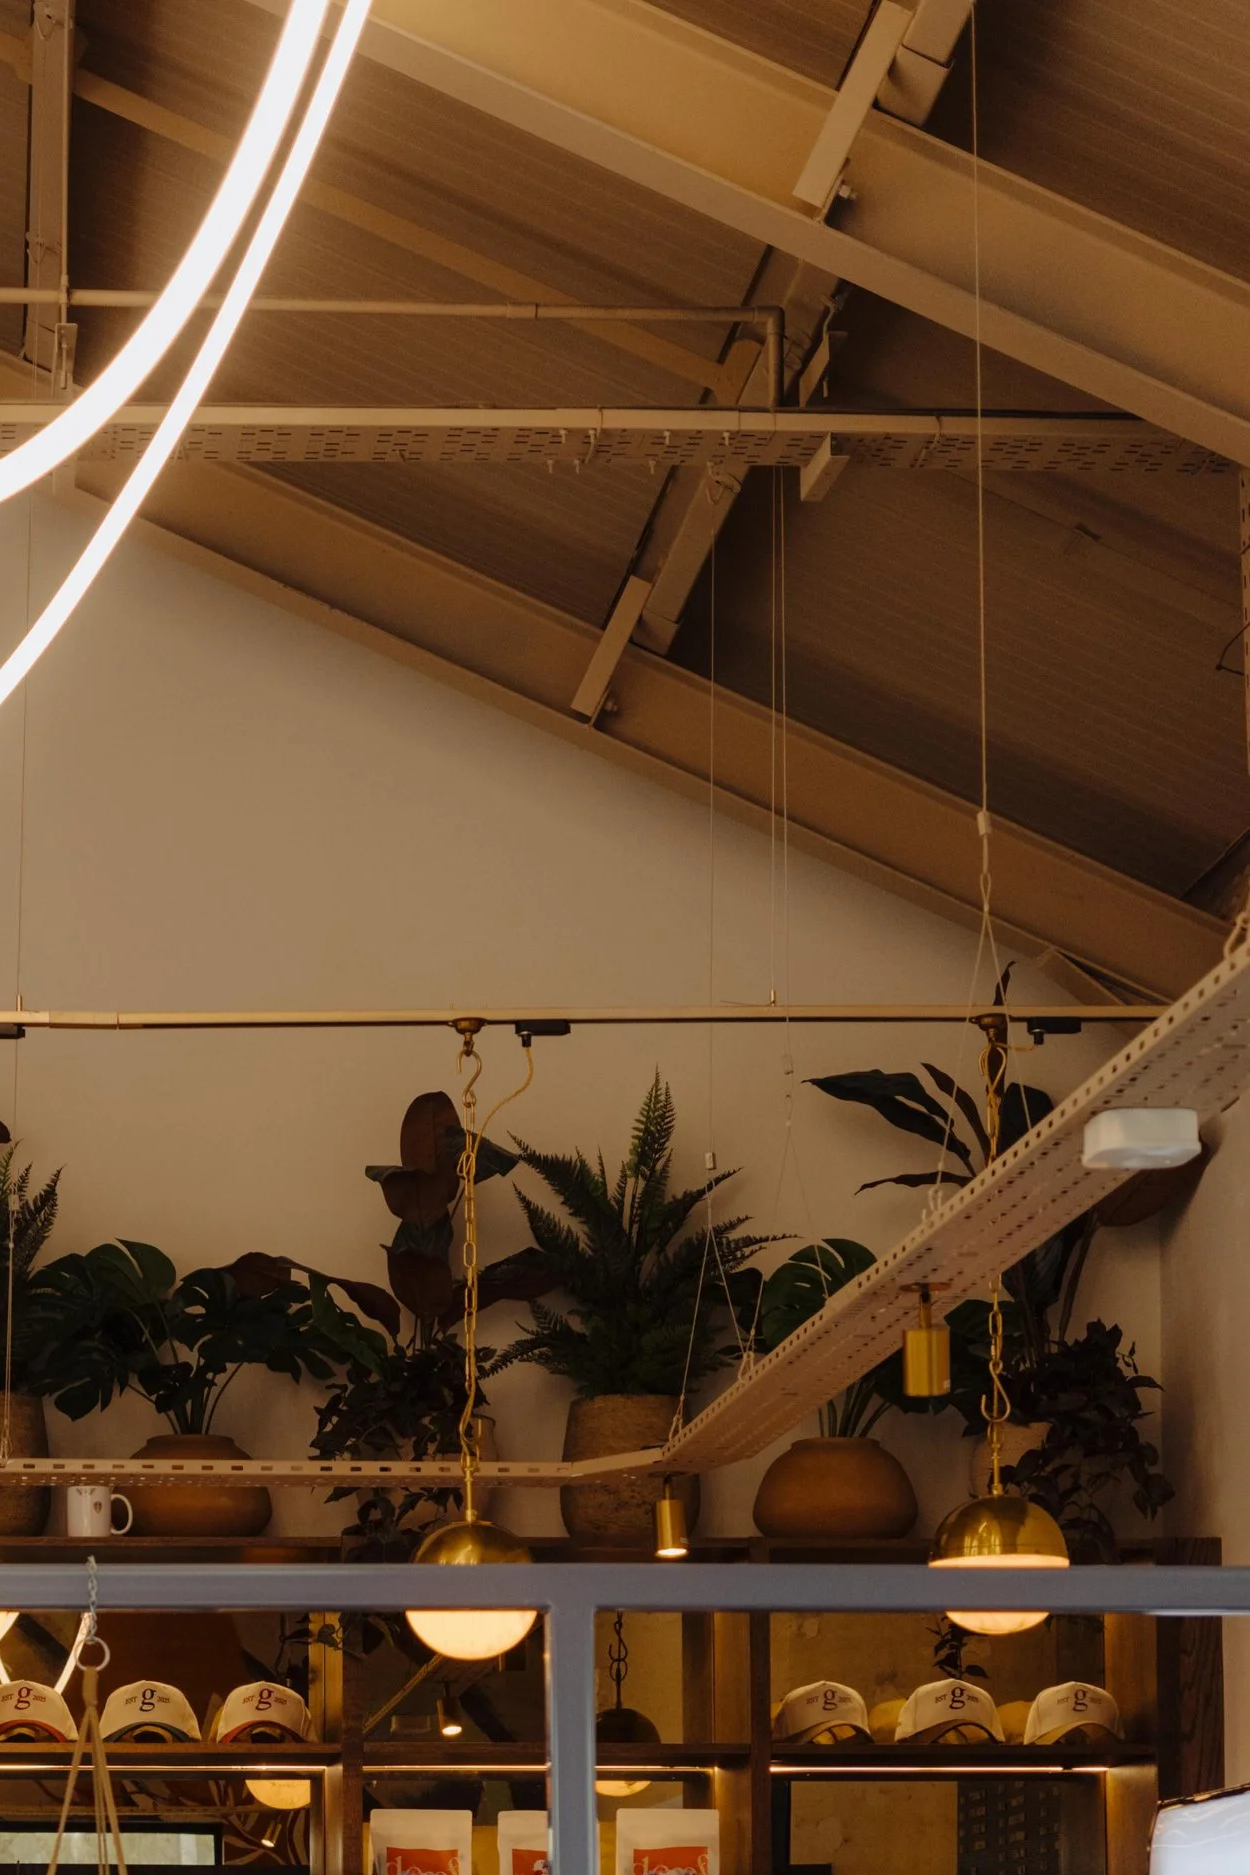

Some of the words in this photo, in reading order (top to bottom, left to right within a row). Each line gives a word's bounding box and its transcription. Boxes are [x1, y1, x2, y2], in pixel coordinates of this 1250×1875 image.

[14, 1686, 33, 1710] g
[139, 1688, 156, 1712] g
[255, 1688, 274, 1711] g
[822, 1688, 838, 1711] g
[949, 1686, 966, 1710] g
[1073, 1688, 1088, 1712] g
